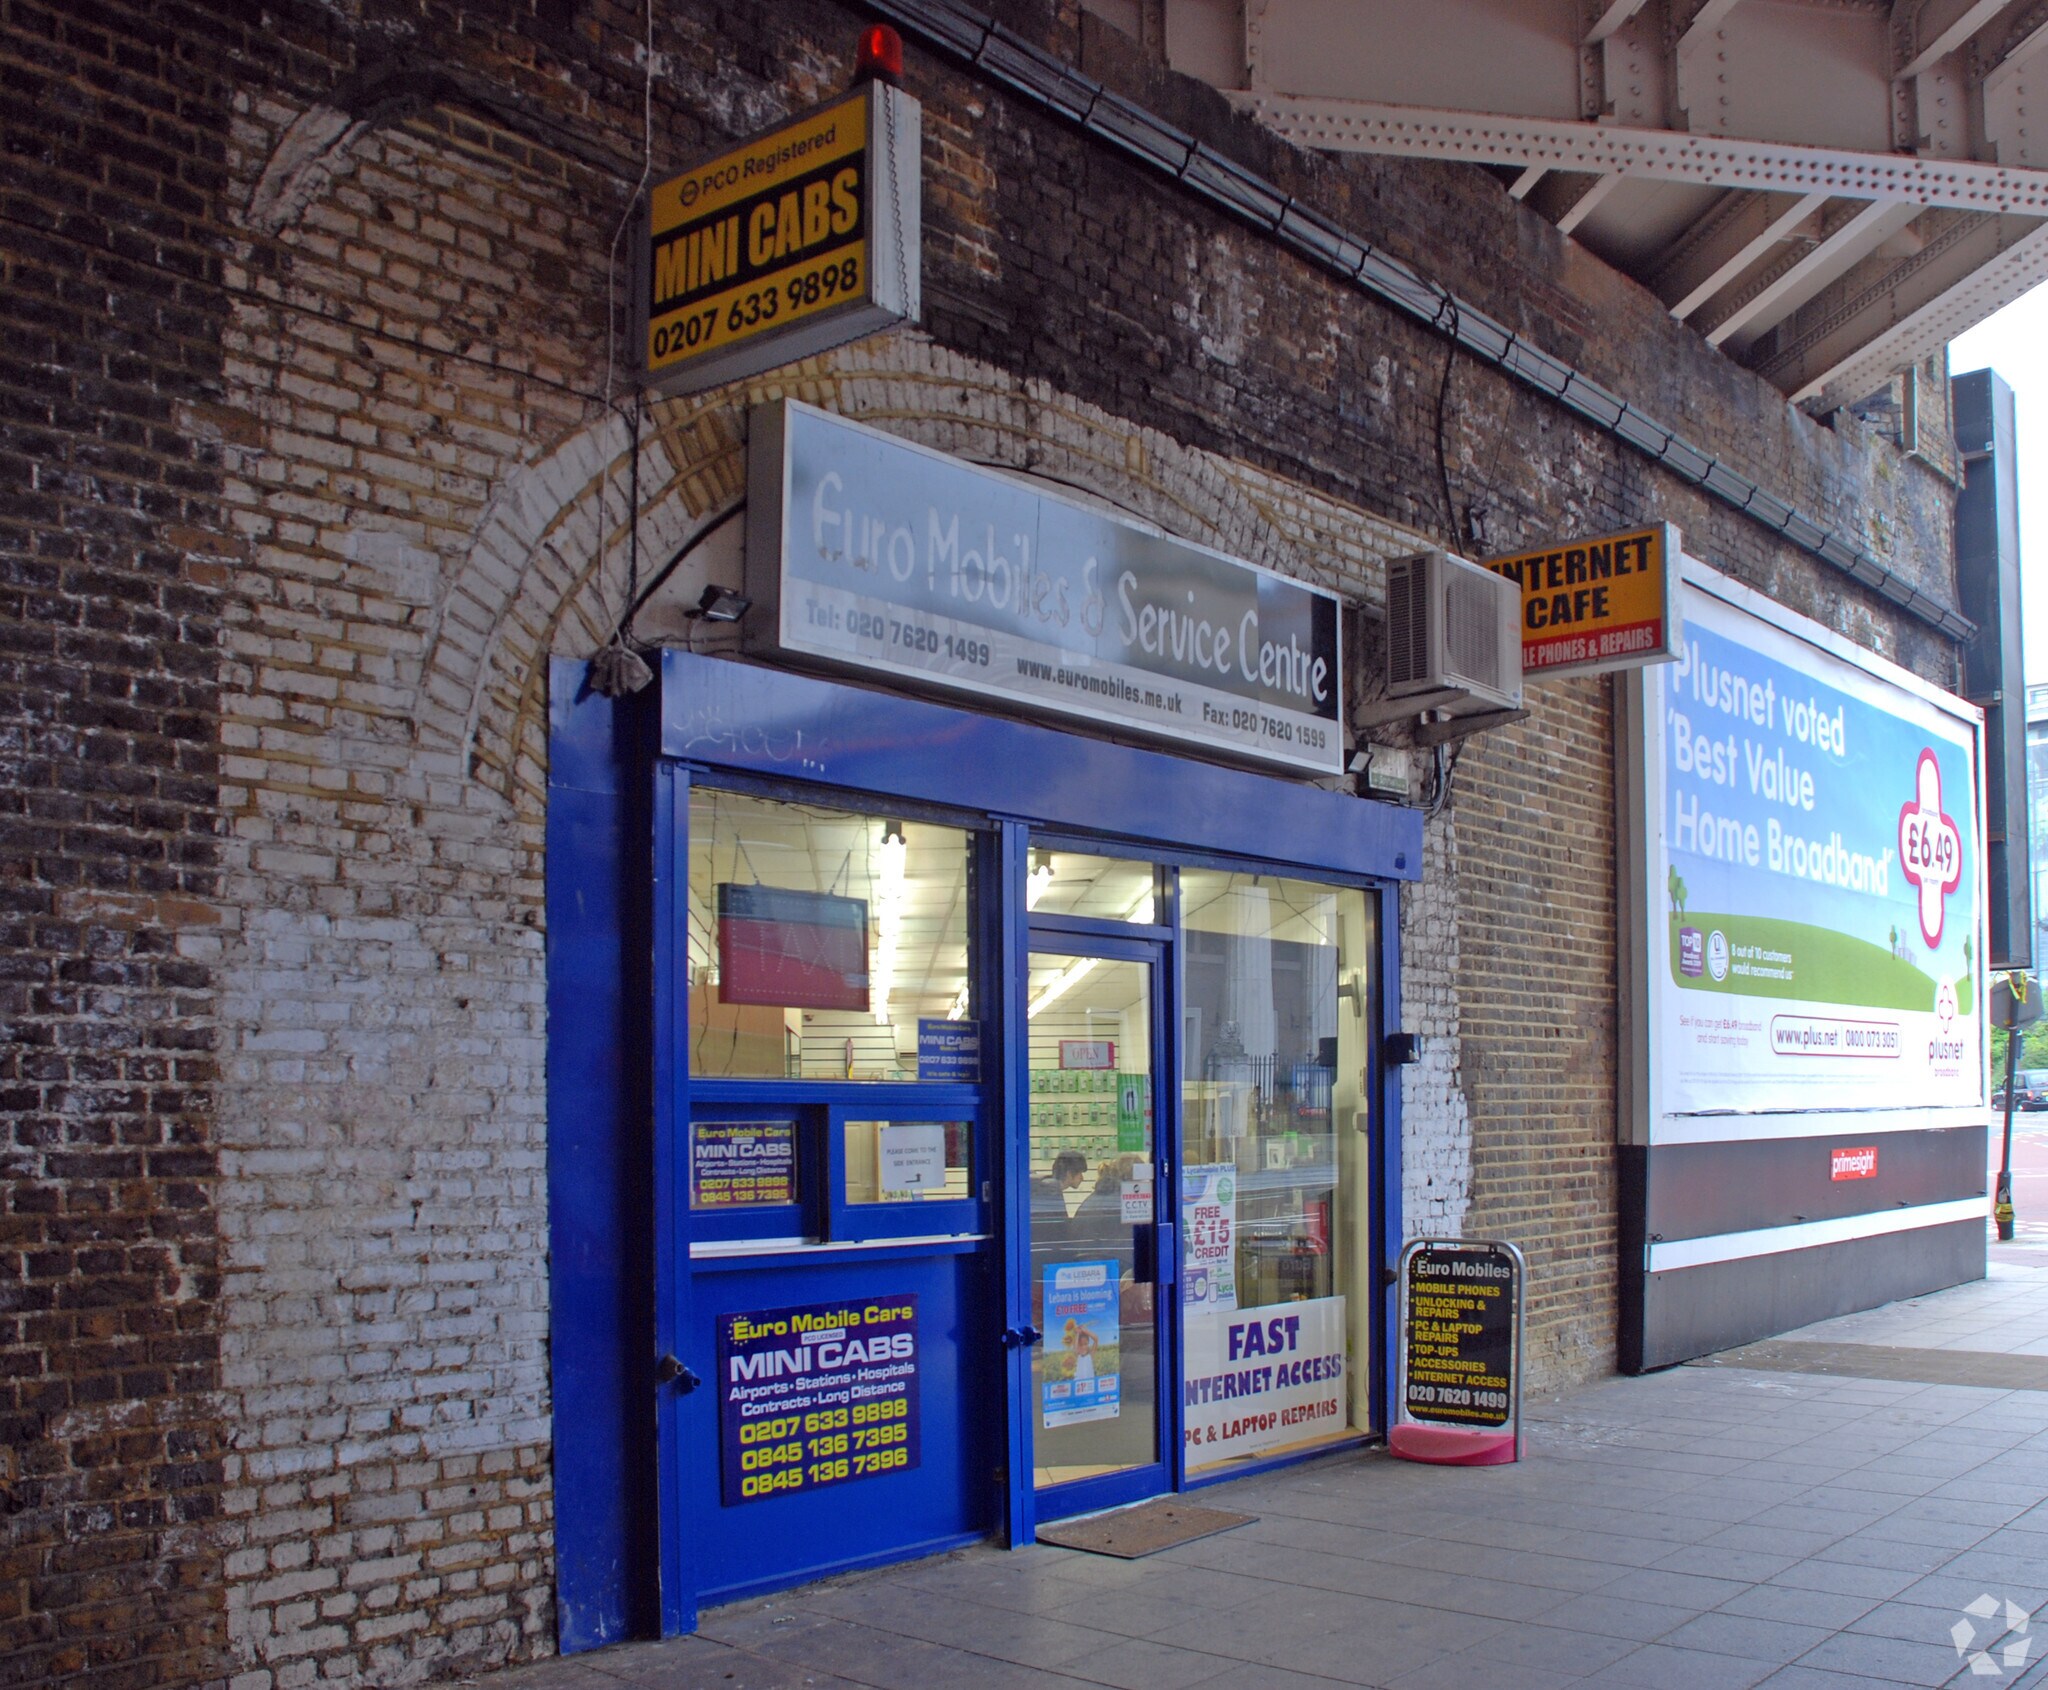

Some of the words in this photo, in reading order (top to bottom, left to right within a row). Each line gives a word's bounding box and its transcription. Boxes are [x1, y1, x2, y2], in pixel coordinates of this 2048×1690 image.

[702, 165, 738, 195] PCO
[744, 124, 836, 178] Registered
[654, 215, 739, 304] MINI
[749, 167, 859, 268] CABS
[653, 308, 718, 359] 0207
[727, 287, 779, 332] 633
[787, 257, 858, 310] 9898
[812, 471, 915, 582] Euro
[927, 505, 1071, 629] Mobiles
[1117, 570, 1231, 674] Service
[1239, 609, 1329, 702] Centre
[1526, 586, 1610, 629] CAFE
[1538, 639, 1585, 666] PHONES
[1588, 639, 1599, 657] &
[1600, 627, 1653, 655] REPAIRS
[806, 600, 840, 627] Tel:
[846, 609, 885, 640] 020
[890, 620, 938, 653] 7620
[944, 636, 990, 666] 1499
[1017, 657, 1182, 714] www.euromobiles.me.uk
[1203, 703, 1229, 727] Fax:
[1232, 708, 1257, 733] 020
[1261, 716, 1293, 741] 7620
[1296, 725, 1326, 749] 1599
[1672, 640, 1776, 729] Plusnet
[1781, 697, 1845, 756] voted
[1744, 738, 1815, 811] Value
[1675, 789, 1759, 866] Home
[1908, 820, 1953, 873] £6.49
[1737, 945, 1746, 958] out
[1747, 944, 1754, 959] of
[1755, 946, 1762, 960] 10
[1762, 949, 1792, 964] customers
[1731, 961, 1749, 975] would
[1750, 965, 1785, 980] recommend
[1679, 1014, 1690, 1027] See
[1695, 1017, 1704, 1030] you
[1704, 1018, 1713, 1028] can
[1714, 1018, 1722, 1031] get
[1722, 1017, 1738, 1030] £6.49
[1738, 1019, 1762, 1032] broadband
[919, 1034, 945, 1045] MINI
[946, 1035, 978, 1046] CABS
[1697, 1032, 1707, 1044] and
[1708, 1033, 1720, 1045] start
[1776, 1025, 1838, 1050] www.plus.net
[1845, 1028, 1864, 1048] 0800
[1866, 1030, 1881, 1048] 073
[919, 1055, 940, 1064] 0207
[1071, 1047, 1100, 1061] OPEN
[1928, 1036, 1963, 1066] plusnet
[698, 1127, 726, 1139] Euro
[727, 1127, 763, 1138] Mobile
[764, 1127, 791, 1137] Cars
[696, 1144, 738, 1159] MINI
[740, 1143, 792, 1158] CABS
[695, 1160, 725, 1168] Airports
[728, 1159, 756, 1167] Stations
[760, 1158, 792, 1167] Hospitals
[701, 1168, 736, 1176] Contracts
[739, 1167, 756, 1176] Long
[756, 1166, 787, 1175] Distance
[1220, 1164, 1235, 1173] PLUS
[1832, 1150, 1875, 1178] primesight
[700, 1178, 730, 1189] 0207
[732, 1177, 755, 1188] 633
[757, 1176, 788, 1187] 9898
[701, 1191, 731, 1203] 0845
[733, 1190, 755, 1201] 136
[1194, 1206, 1220, 1220] FREE
[1194, 1218, 1230, 1246] £15
[1195, 1245, 1229, 1259] CREDIT
[1073, 1269, 1101, 1278] LEBARA
[1417, 1259, 1450, 1276] Euro
[1452, 1261, 1510, 1279] Mobiles
[1048, 1292, 1072, 1304] Lebara
[1073, 1291, 1079, 1302] is
[1080, 1289, 1113, 1301] blooming
[1218, 1284, 1233, 1293] Lyca
[1416, 1283, 1456, 1295] MOBILE
[1458, 1286, 1500, 1298] PHONES
[1056, 1305, 1068, 1317] £10
[1070, 1303, 1088, 1315] FREE
[1415, 1297, 1474, 1311] UNLOCKING
[1477, 1300, 1486, 1311] &
[1415, 1306, 1459, 1320] REPAIRS
[733, 1321, 788, 1340] Euro
[792, 1309, 861, 1333] Mobile
[864, 1305, 913, 1324] Cars
[1415, 1320, 1430, 1332] PC
[1431, 1321, 1440, 1332] &
[1442, 1322, 1482, 1335] LAPTOP
[816, 1331, 844, 1340] LICENSED
[1228, 1315, 1300, 1362] FAST
[1415, 1330, 1459, 1344] REPAIRS
[730, 1346, 811, 1382] MINI
[818, 1333, 914, 1370] CABS
[1414, 1344, 1459, 1357] TOP-UPS
[1414, 1359, 1486, 1372] ACCESSORIES
[729, 1382, 789, 1402] Airports
[795, 1372, 851, 1391] Stations
[857, 1362, 915, 1381] Hospitals
[1184, 1366, 1272, 1406] NTERNET
[1276, 1353, 1342, 1391] ACCESS
[1414, 1371, 1464, 1385] INTERNET
[1466, 1375, 1507, 1388] ACCESS
[741, 1396, 811, 1417] Contracts
[818, 1389, 849, 1405] Long
[851, 1381, 905, 1399] Distance
[1409, 1385, 1434, 1402] 020
[1437, 1388, 1471, 1405] 7620
[1473, 1391, 1507, 1409] 1499
[740, 1416, 801, 1444] 0207
[805, 1408, 848, 1433] 633
[852, 1398, 908, 1424] 9898
[1206, 1425, 1217, 1444] &
[1222, 1411, 1277, 1440] LAPTOP
[1281, 1398, 1338, 1428] REPAIRS
[1408, 1404, 1506, 1421] www.euromobiles.me.uk
[741, 1442, 803, 1471] 0845
[808, 1433, 848, 1457] 136
[852, 1423, 908, 1449] 7395
[742, 1468, 803, 1497] 0845
[808, 1459, 849, 1483] 136
[852, 1447, 908, 1474] 7396
